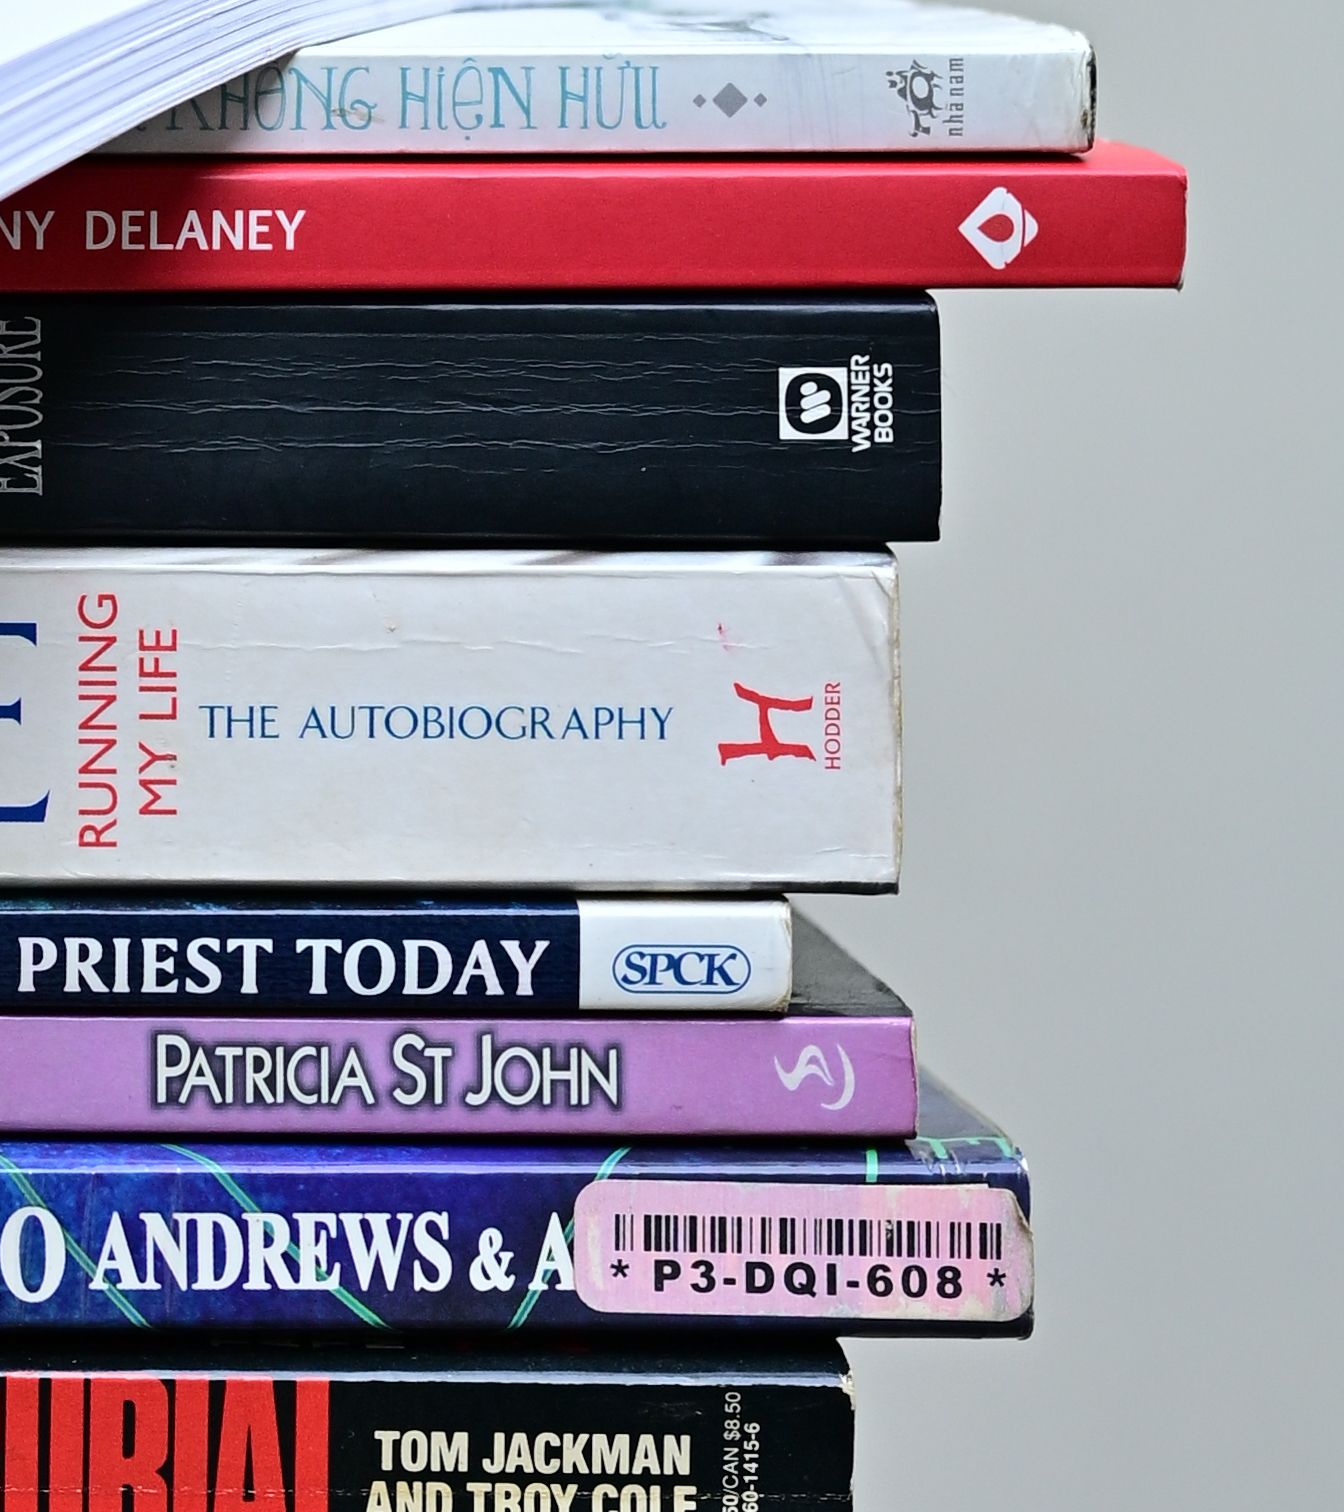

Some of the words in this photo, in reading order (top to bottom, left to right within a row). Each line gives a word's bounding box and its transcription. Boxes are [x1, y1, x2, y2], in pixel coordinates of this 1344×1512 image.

[948, 58, 964, 97] nam
[85, 210, 306, 251] DELANEY
[850, 354, 871, 453] WARNER
[874, 362, 894, 444] BOOKS
[139, 628, 178, 721] LIFE
[77, 593, 119, 848] RUNNING
[199, 705, 280, 739] THE
[298, 704, 675, 741] AUTOBIOGRAPHY
[824, 681, 841, 771] HODDER
[139, 741, 178, 816] MY
[18, 936, 272, 996] PRIEST
[296, 937, 551, 998] TODAY
[621, 950, 740, 988] SPCK
[89, 1211, 454, 1293] ANDREWS
[468, 1225, 516, 1292] &
[723, 1391, 742, 1441] $8.50
[374, 1430, 470, 1473] TOM
[482, 1432, 692, 1476] JACKMAN
